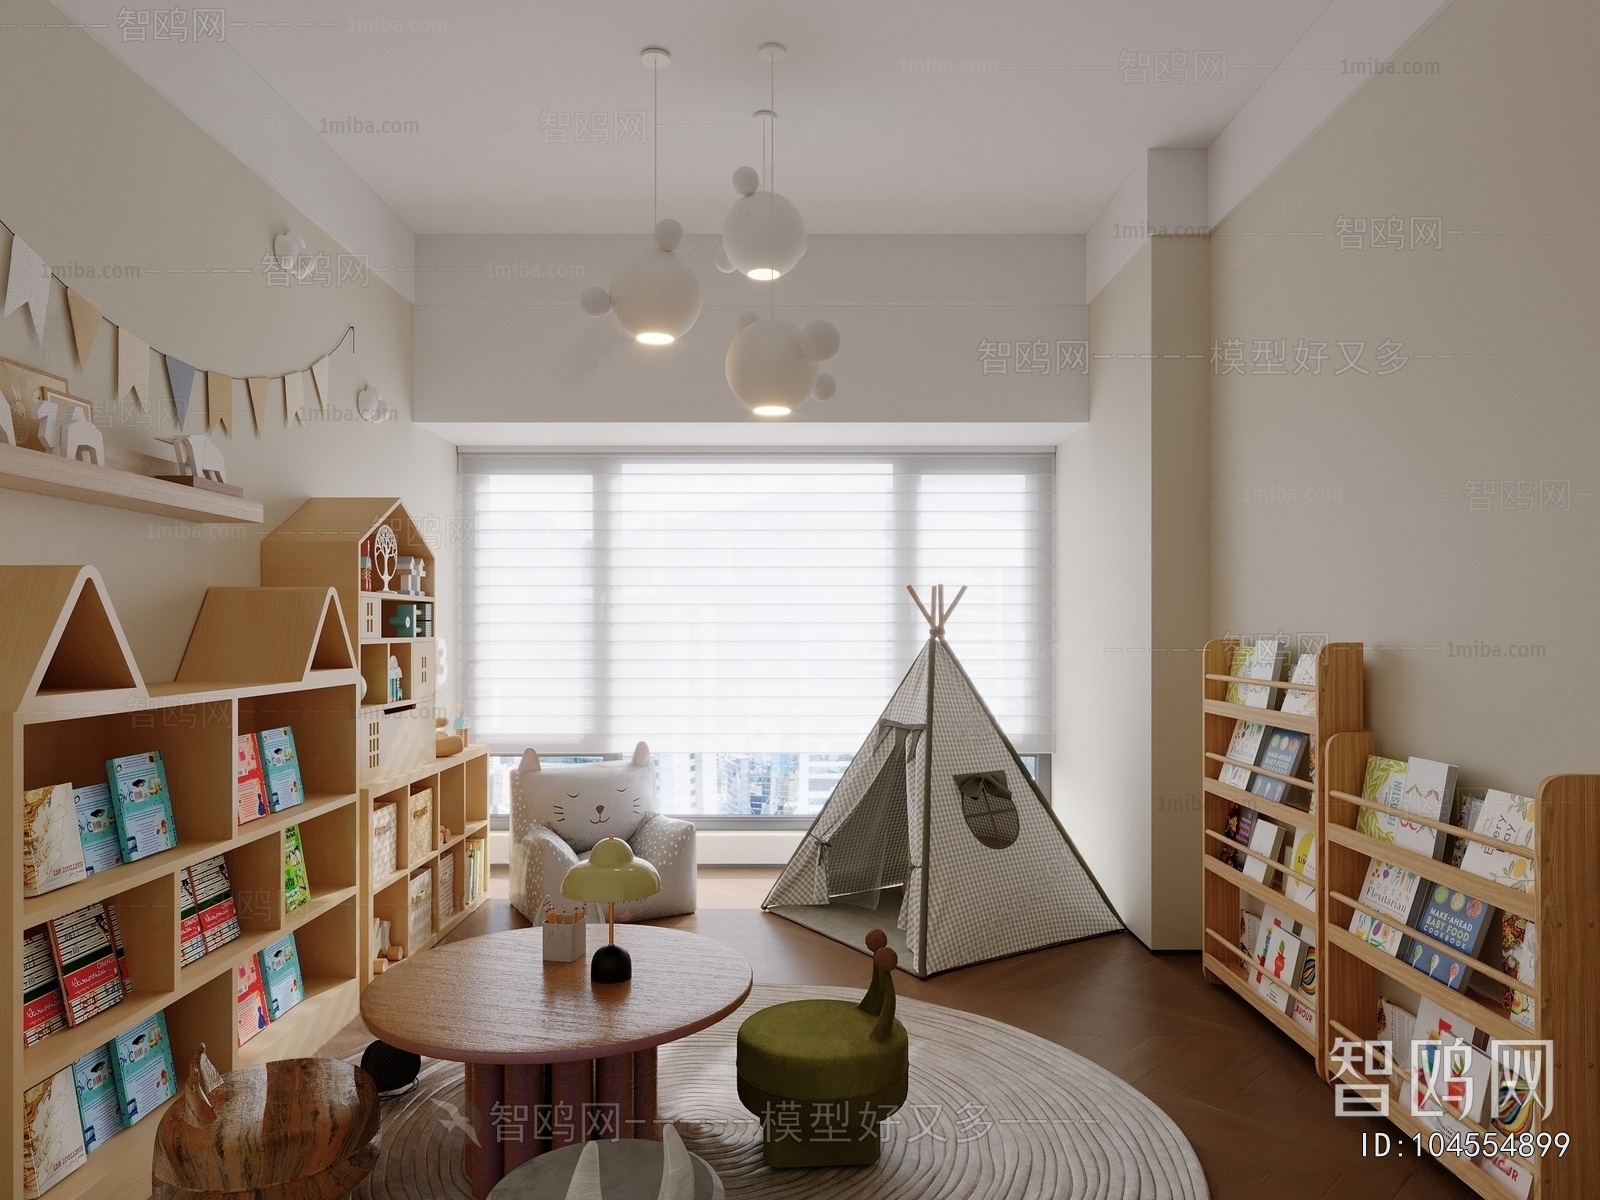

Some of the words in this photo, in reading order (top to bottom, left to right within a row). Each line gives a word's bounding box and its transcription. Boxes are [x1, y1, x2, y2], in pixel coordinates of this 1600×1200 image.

[1387, 780, 1403, 827] FAASTIN
[1484, 814, 1508, 856] Eery
[1496, 823, 1516, 853] ay
[1426, 915, 1447, 931] BABY
[1446, 925, 1470, 942] FOOD
[1429, 907, 1473, 932] MAKE-AHEAD
[1423, 925, 1467, 949] COOKBOOK
